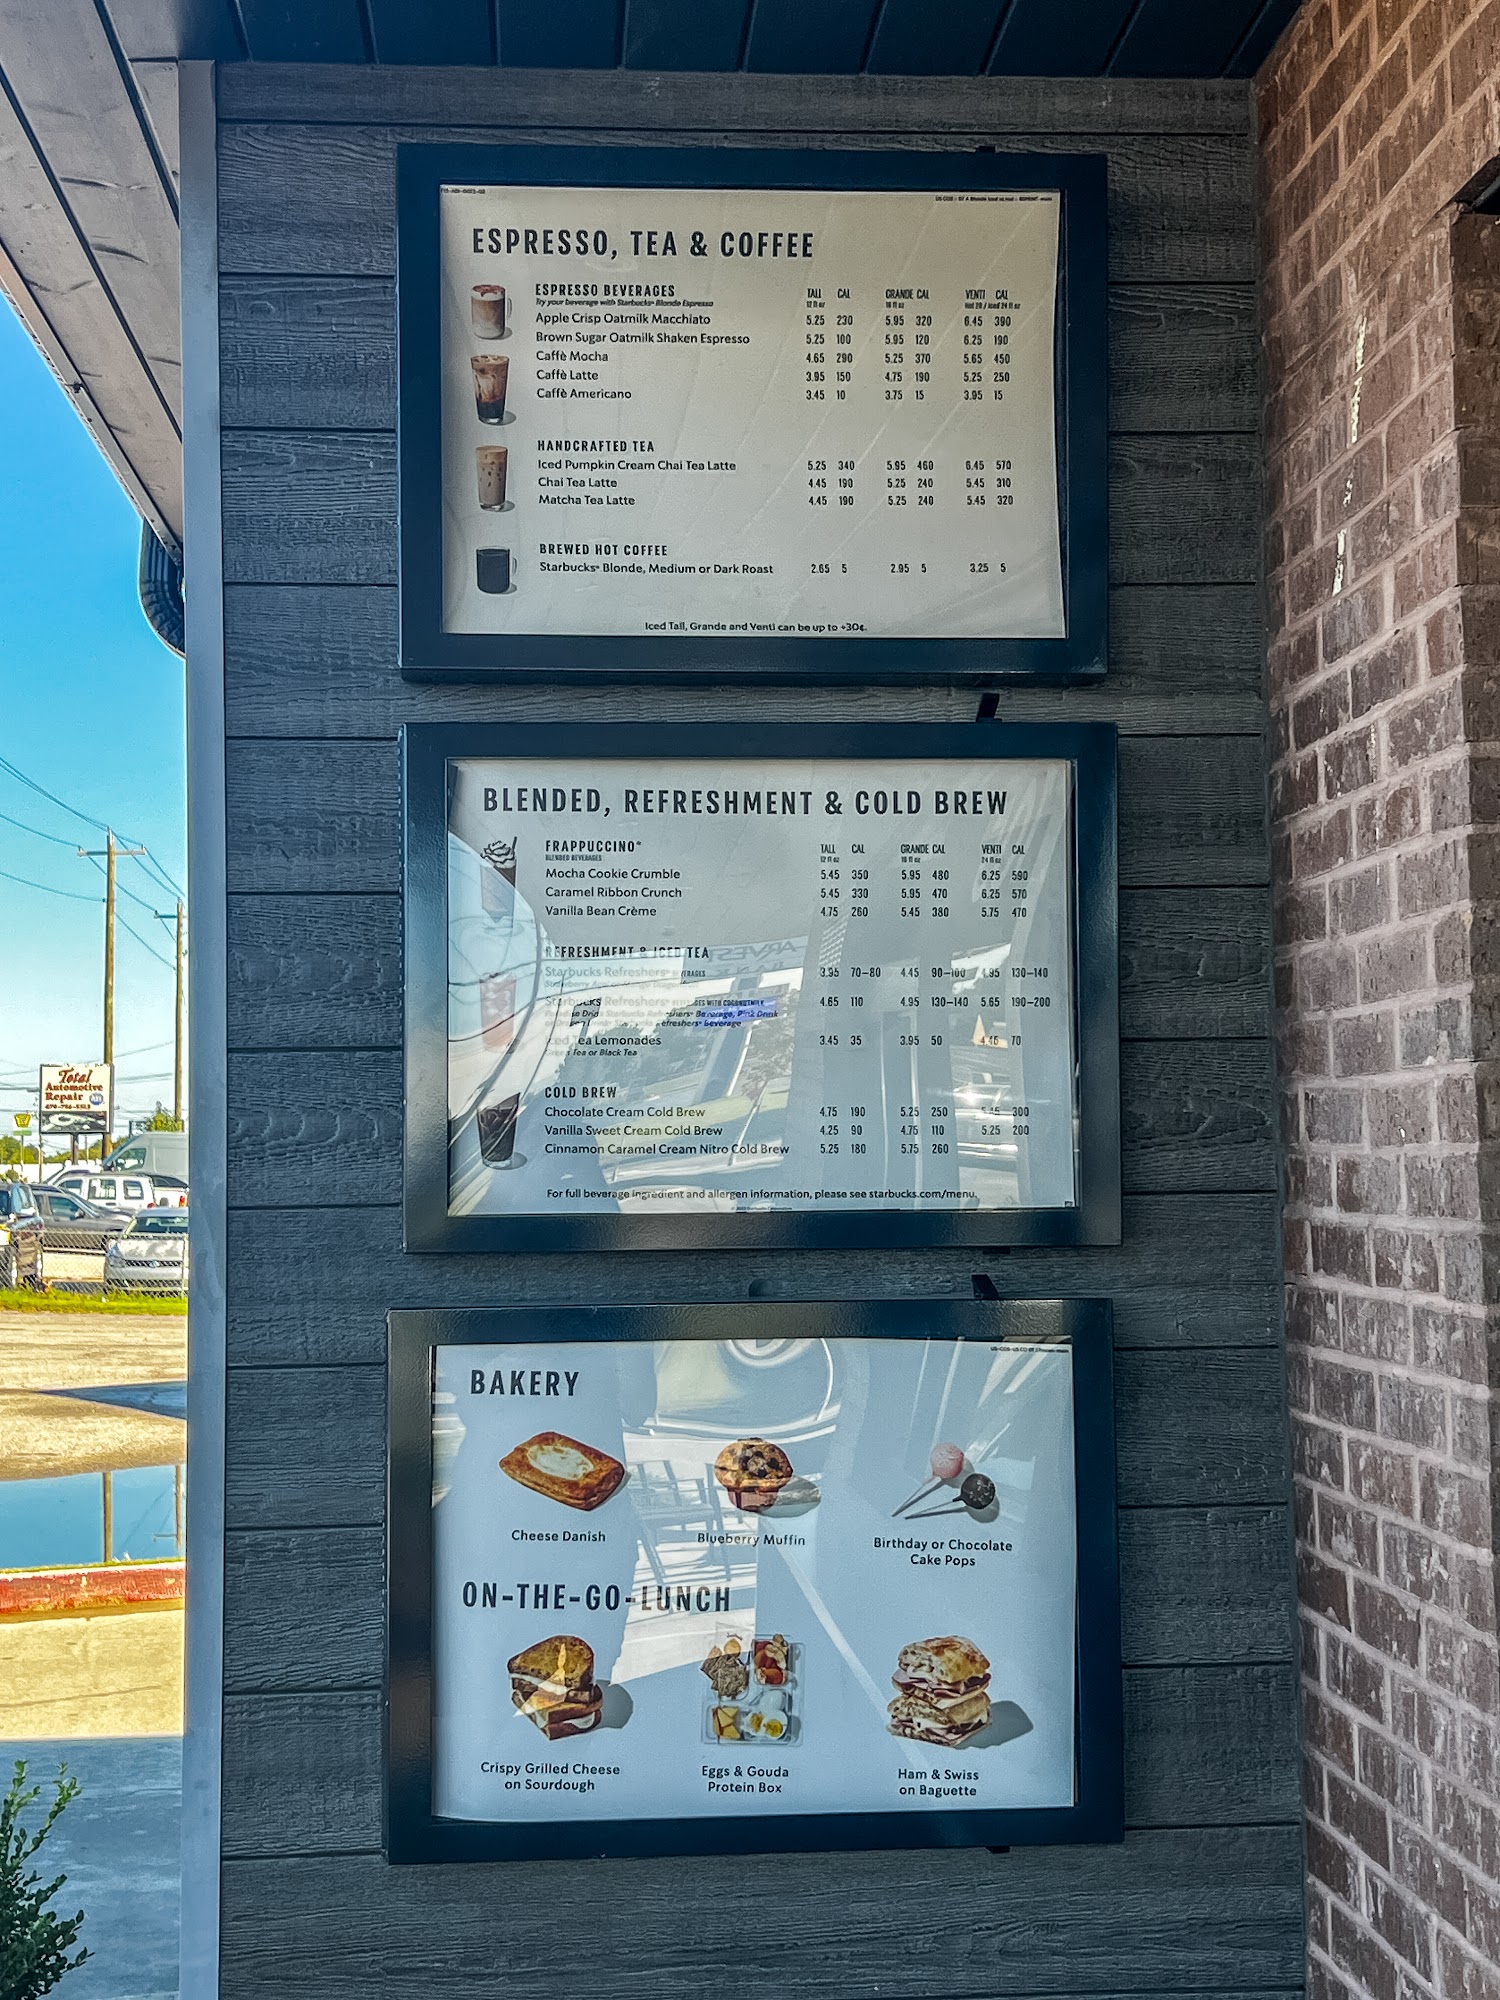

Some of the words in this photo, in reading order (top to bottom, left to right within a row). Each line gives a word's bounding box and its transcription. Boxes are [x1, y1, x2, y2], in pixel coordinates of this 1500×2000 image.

[473, 228, 618, 260] ESPRESSO,
[630, 231, 677, 256] TEA
[689, 231, 709, 256] &
[719, 232, 814, 258] COFFEE
[536, 284, 598, 296] ESPRESSO
[604, 284, 675, 297] BEVERAGES
[536, 312, 570, 325] Apple
[572, 313, 601, 326] Crisp
[604, 314, 649, 324] Oatmilk
[652, 314, 711, 325] Macchiato
[806, 315, 825, 326] 5.25
[836, 315, 853, 326] 230
[885, 315, 904, 326] 5.95
[915, 315, 932, 326] 320
[964, 316, 983, 327] 6.45
[994, 316, 1011, 327] 390
[536, 332, 573, 342] Brown
[576, 332, 607, 345] Sugar
[610, 332, 654, 343] Oatmilk
[657, 332, 698, 344] Shaken
[701, 333, 750, 346] Espresso
[536, 350, 567, 362] Caffè
[570, 351, 608, 362] Mocha
[536, 368, 567, 380] Caffè
[570, 370, 599, 380] Latte
[537, 388, 567, 399] Caffè
[570, 388, 632, 399] Americano
[538, 440, 627, 452] HANDCRAFTED
[633, 441, 654, 452] TEA
[538, 459, 562, 470] Iced
[565, 460, 615, 472] Pumpkin
[618, 460, 655, 470] Cream
[658, 460, 683, 470] Chai
[686, 460, 705, 471] Tea
[708, 461, 736, 471] Latte
[538, 477, 564, 487] Chai
[566, 478, 586, 488] Tea
[589, 478, 617, 488] Latte
[539, 495, 582, 505] Matcha
[584, 495, 604, 505] Tea
[606, 496, 635, 506] Latte
[540, 544, 589, 555] BREWED
[595, 544, 618, 556] HOT
[624, 545, 667, 556] COFFEE
[603, 563, 646, 575] Blonde,
[649, 564, 696, 574] Medium
[699, 566, 711, 574] or
[714, 564, 740, 574] Dark
[742, 564, 774, 574] Roast
[811, 564, 830, 573] 2.65
[890, 564, 910, 573] 2.95
[969, 563, 989, 573] 3.25
[645, 622, 667, 631] Iced
[668, 622, 688, 632] Tall,
[690, 622, 727, 631] Grande
[729, 622, 748, 631] and
[750, 622, 776, 631] Venti
[798, 623, 811, 631] be
[812, 625, 825, 635] up
[828, 624, 838, 632] to
[484, 788, 610, 817] BLENDED,
[625, 789, 812, 814] REFRESHMENT
[825, 791, 843, 815] &
[856, 791, 921, 815] COLD
[935, 791, 1007, 814] BREW
[571, 854, 602, 862] BEVERAGES
[546, 868, 585, 879] Mocha
[588, 868, 628, 879] Cookie
[631, 868, 680, 879] Crumble
[820, 870, 839, 880] 5.45
[851, 870, 869, 880] 350
[901, 870, 921, 881] 5.95
[932, 870, 949, 881] 480
[981, 870, 1000, 881] 6.25
[1011, 870, 1028, 881] 590
[546, 887, 594, 897] Caramel
[598, 886, 638, 898] Ribbon
[641, 887, 682, 898] Crunch
[545, 905, 583, 916] Vanilla
[587, 906, 615, 916] Bean
[618, 906, 657, 916] Crème
[688, 947, 709, 958] TEA
[573, 1036, 592, 1046] Tea
[595, 1035, 662, 1046] Lemonades
[59, 1068, 93, 1083] Total
[45, 1082, 103, 1091] Automotive
[45, 1092, 83, 1103] Repair
[545, 1087, 576, 1098] COLD
[582, 1087, 617, 1098] BREW
[545, 1107, 603, 1117] Chocolate
[606, 1107, 644, 1117] Cream
[647, 1107, 673, 1117] Cold
[676, 1107, 705, 1117] Brew
[545, 1125, 583, 1135] Vanilla
[586, 1126, 621, 1136] Sweet
[623, 1126, 662, 1136] Cream
[665, 1126, 691, 1136] Cold
[694, 1126, 723, 1136] Brew
[545, 1144, 604, 1154] Cinnamon
[608, 1144, 656, 1154] Caramel
[659, 1144, 697, 1154] Cream
[700, 1144, 729, 1154] Nitro
[731, 1144, 757, 1154] Cold
[760, 1144, 789, 1154] Brew
[547, 1190, 563, 1199] For
[565, 1189, 581, 1199] full
[583, 1189, 630, 1201] beverage
[632, 1189, 684, 1201] ingredient
[686, 1189, 706, 1199] and
[708, 1189, 748, 1201] allergen
[750, 1189, 813, 1201] information,
[814, 1190, 847, 1200] please
[850, 1191, 867, 1199] see
[869, 1189, 977, 1200] starbucks.com/menu.
[471, 1369, 579, 1396] BAKERY
[512, 1530, 559, 1541] Cheese
[563, 1531, 606, 1542] Danish
[697, 1533, 760, 1547] Blueberry
[763, 1534, 805, 1546] Muffin
[874, 1537, 928, 1552] Birthday
[932, 1542, 945, 1550] or
[949, 1539, 1013, 1552] Chocolate
[910, 1555, 941, 1566] Cake
[945, 1555, 976, 1568] Pops
[463, 1582, 730, 1611] ON-THE-GO-LUNCH
[481, 1762, 521, 1776] Crispy
[525, 1763, 569, 1774] Grilled
[573, 1764, 620, 1775] Cheese
[702, 1766, 730, 1779] Eggs
[734, 1766, 743, 1777] &
[747, 1766, 789, 1777] Gouda
[898, 1768, 927, 1780] Ham
[931, 1769, 941, 1780] &
[944, 1769, 979, 1781] Swiss
[505, 1781, 521, 1790] on
[525, 1779, 595, 1793] Sourdough
[708, 1782, 754, 1793] Protein
[759, 1782, 782, 1793] Box
[899, 1787, 915, 1795] on
[920, 1785, 977, 1798] Baguette
